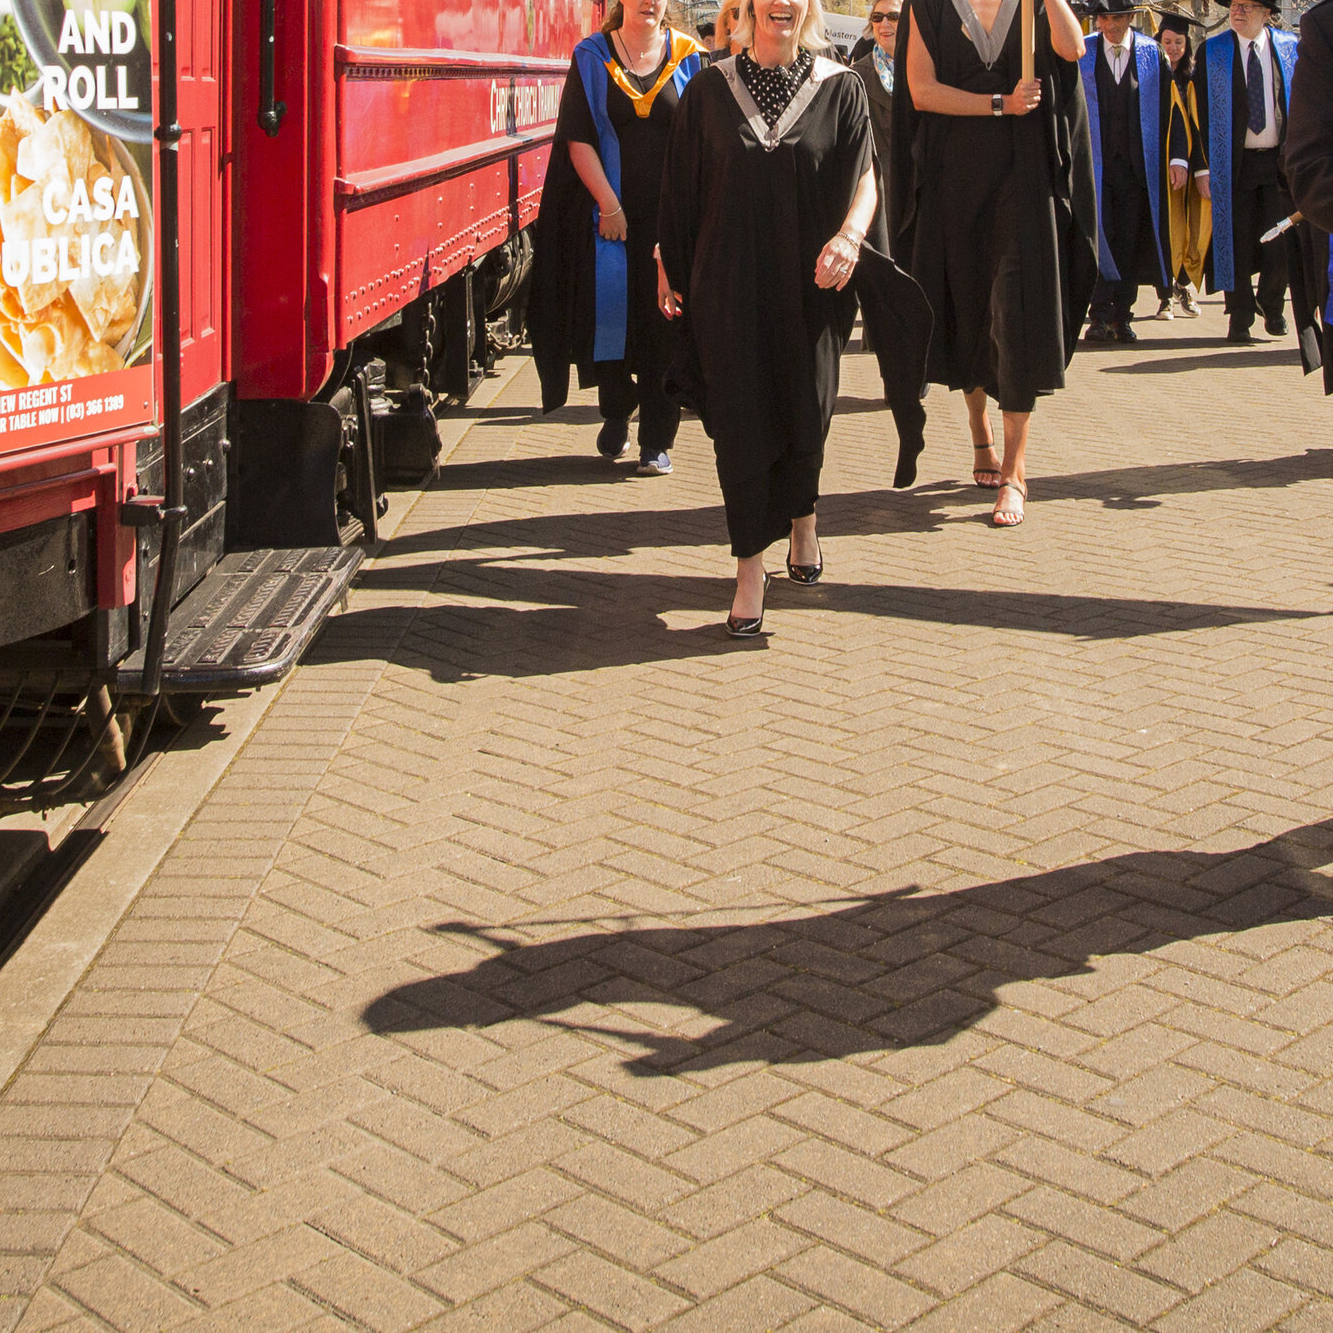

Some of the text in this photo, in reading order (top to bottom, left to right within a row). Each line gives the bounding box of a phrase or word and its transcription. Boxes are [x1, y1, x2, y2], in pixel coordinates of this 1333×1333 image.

[58, 10, 137, 55] AND
[825, 28, 858, 41] Masters
[43, 65, 139, 110] ROLL
[42, 175, 140, 225] CASA
[18, 387, 58, 411] REGENT
[60, 384, 73, 403] ST
[9, 411, 37, 432] TABLE
[38, 408, 59, 426] NOW
